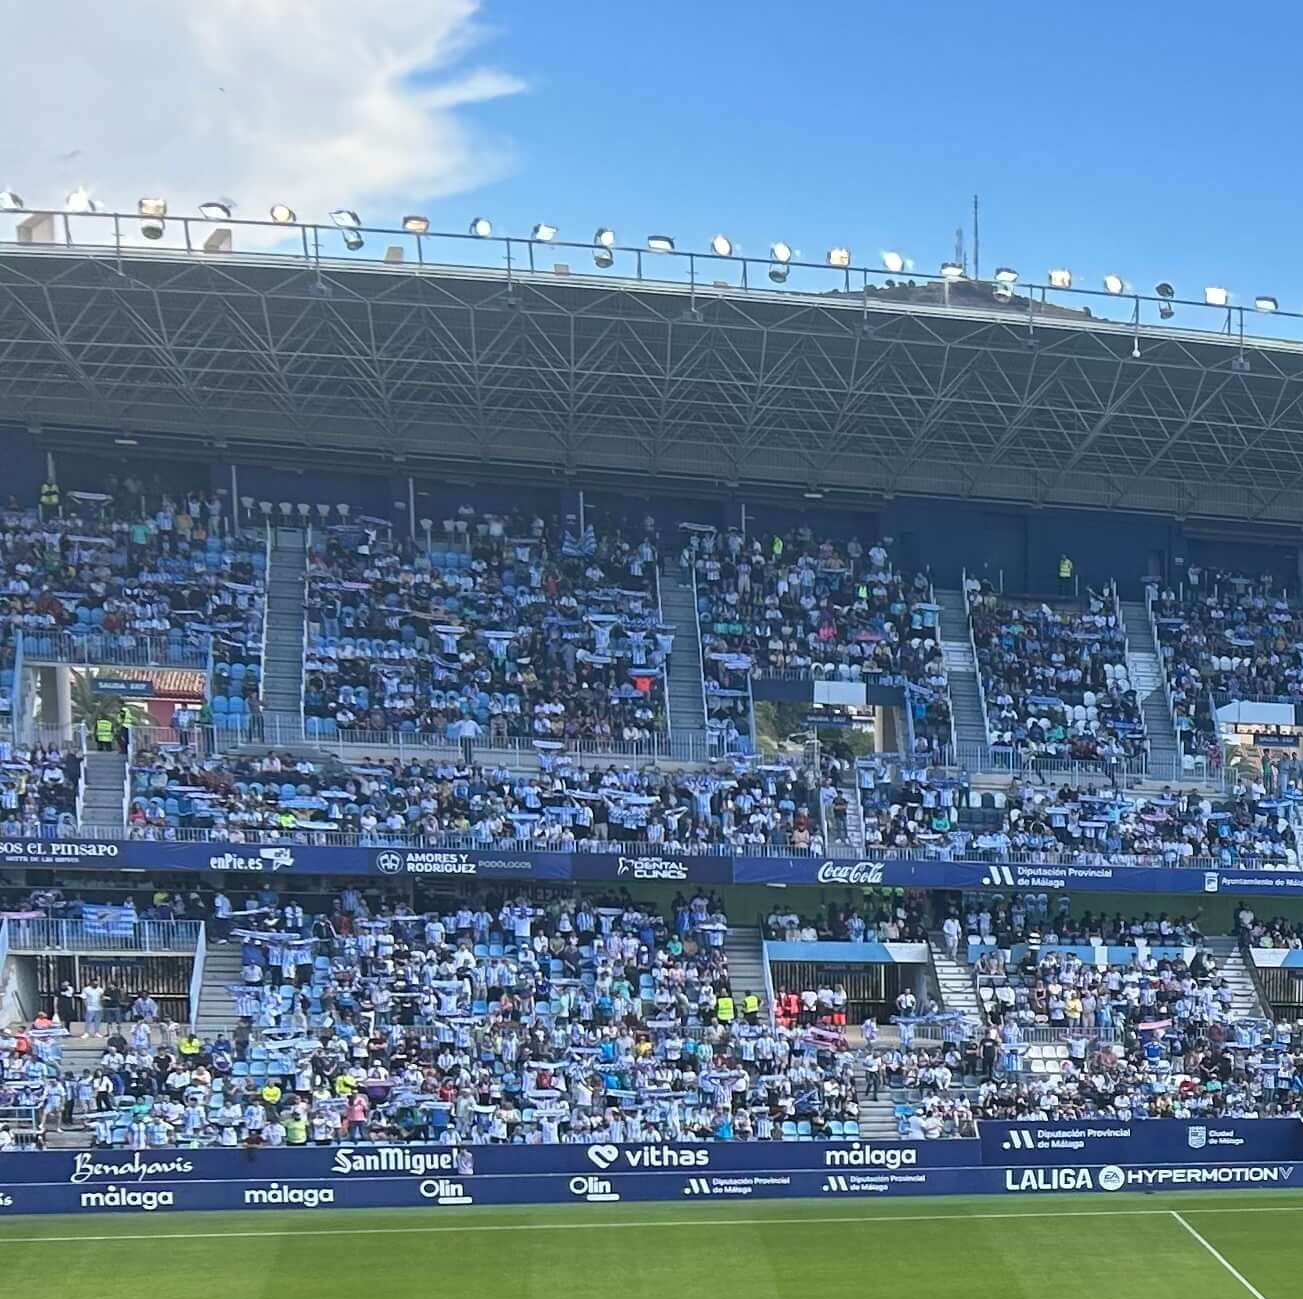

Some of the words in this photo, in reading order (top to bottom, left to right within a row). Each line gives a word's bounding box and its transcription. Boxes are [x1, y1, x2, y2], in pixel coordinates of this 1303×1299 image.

[407, 853, 457, 863] AMORES
[459, 854, 468, 863] Y
[634, 862, 688, 871] DENTAL
[1068, 868, 1112, 877] Provincial
[634, 870, 687, 879] CLINICS
[1017, 878, 1032, 887] de
[1033, 877, 1065, 889] Málaga
[1037, 1129, 1085, 1140] Diputación
[1087, 1128, 1130, 1138] Provincial
[1037, 1140, 1049, 1149] de
[1051, 1140, 1084, 1150] Málaga
[625, 1146, 709, 1167] vithas
[569, 1177, 611, 1194] Olin
[1005, 1168, 1093, 1191] LALIGA
[419, 1179, 463, 1197] Olin
